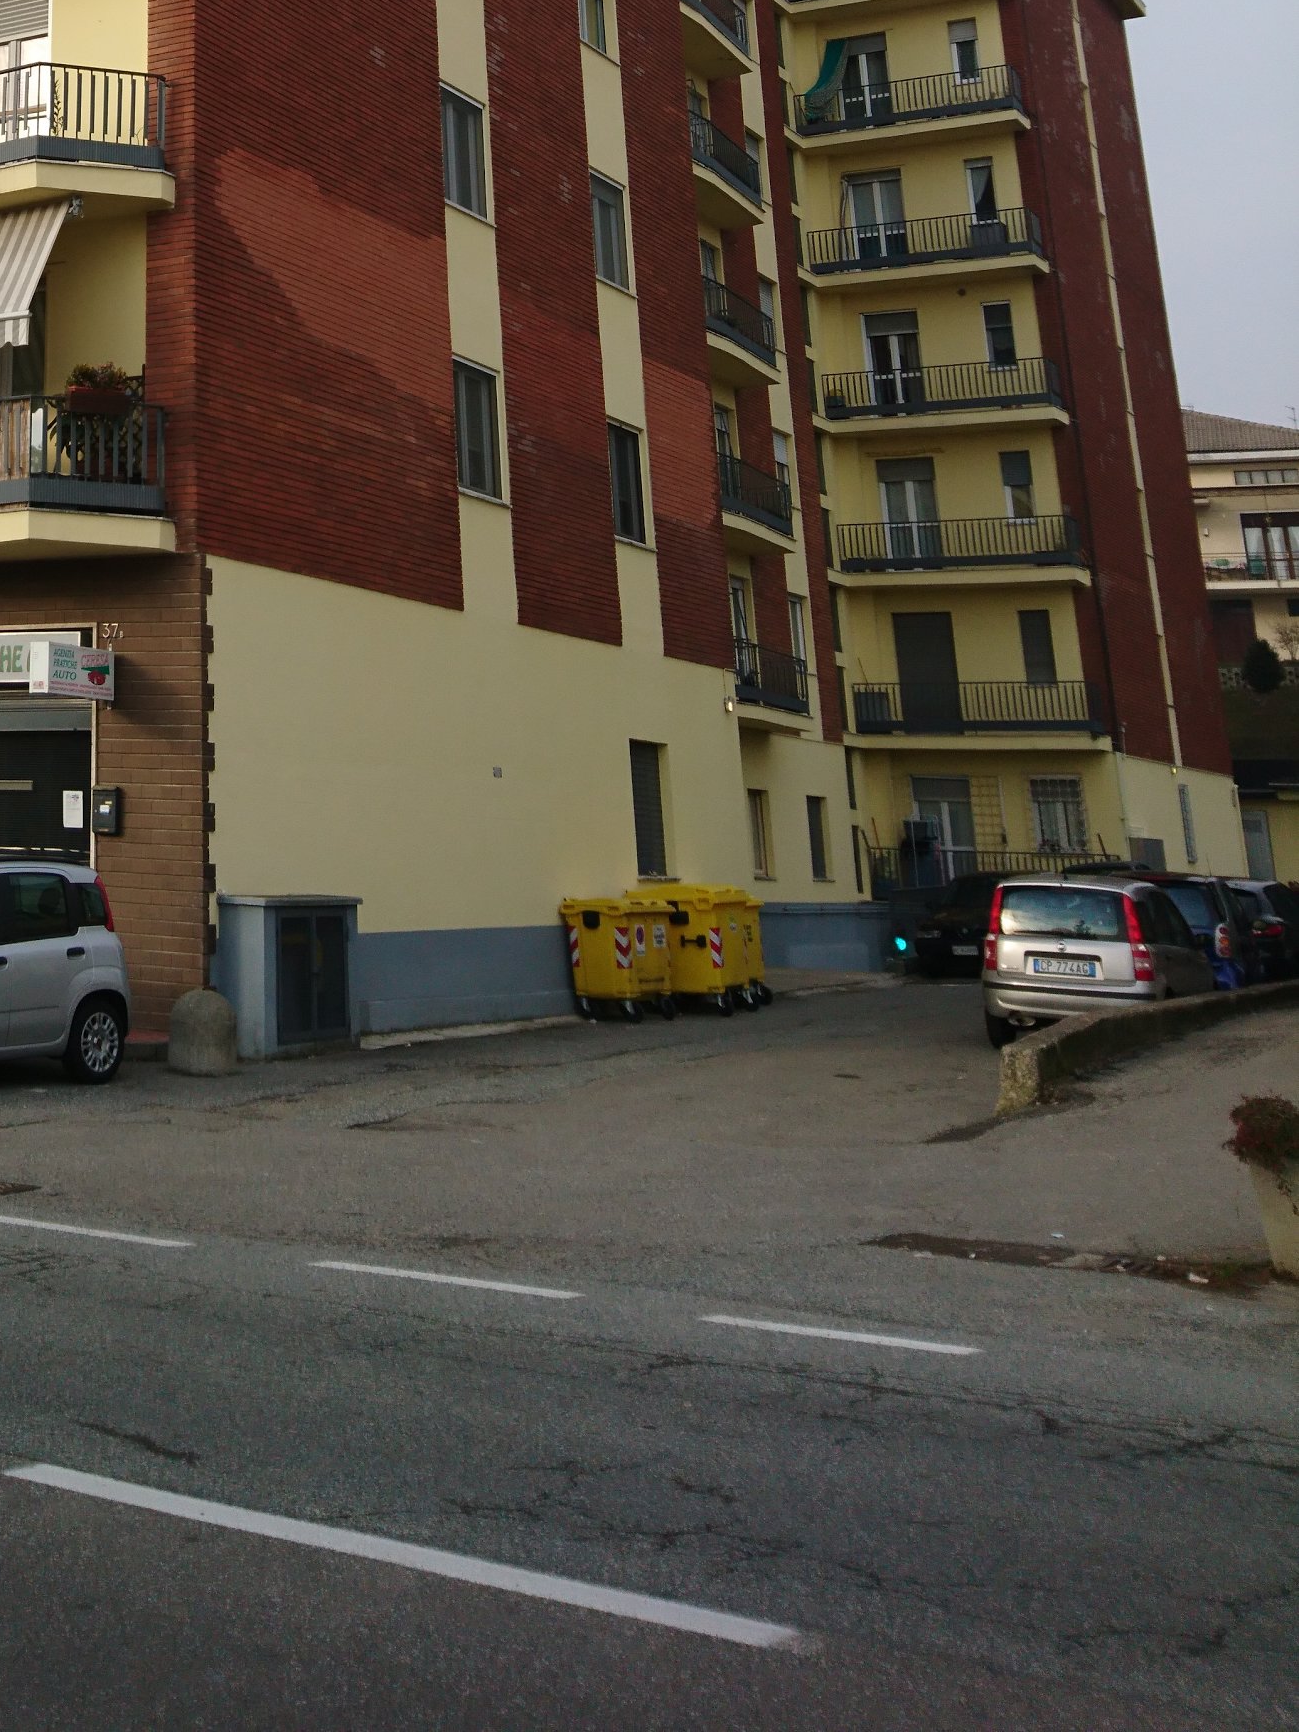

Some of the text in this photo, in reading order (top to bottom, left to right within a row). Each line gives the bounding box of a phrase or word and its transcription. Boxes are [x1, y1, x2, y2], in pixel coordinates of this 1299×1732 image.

[53, 648, 75, 659] AGENZIA
[53, 658, 78, 670] PRATICHE
[81, 653, 109, 667] CERESA
[52, 670, 77, 681] AUTO
[1041, 960, 1088, 975] CP 774AG
